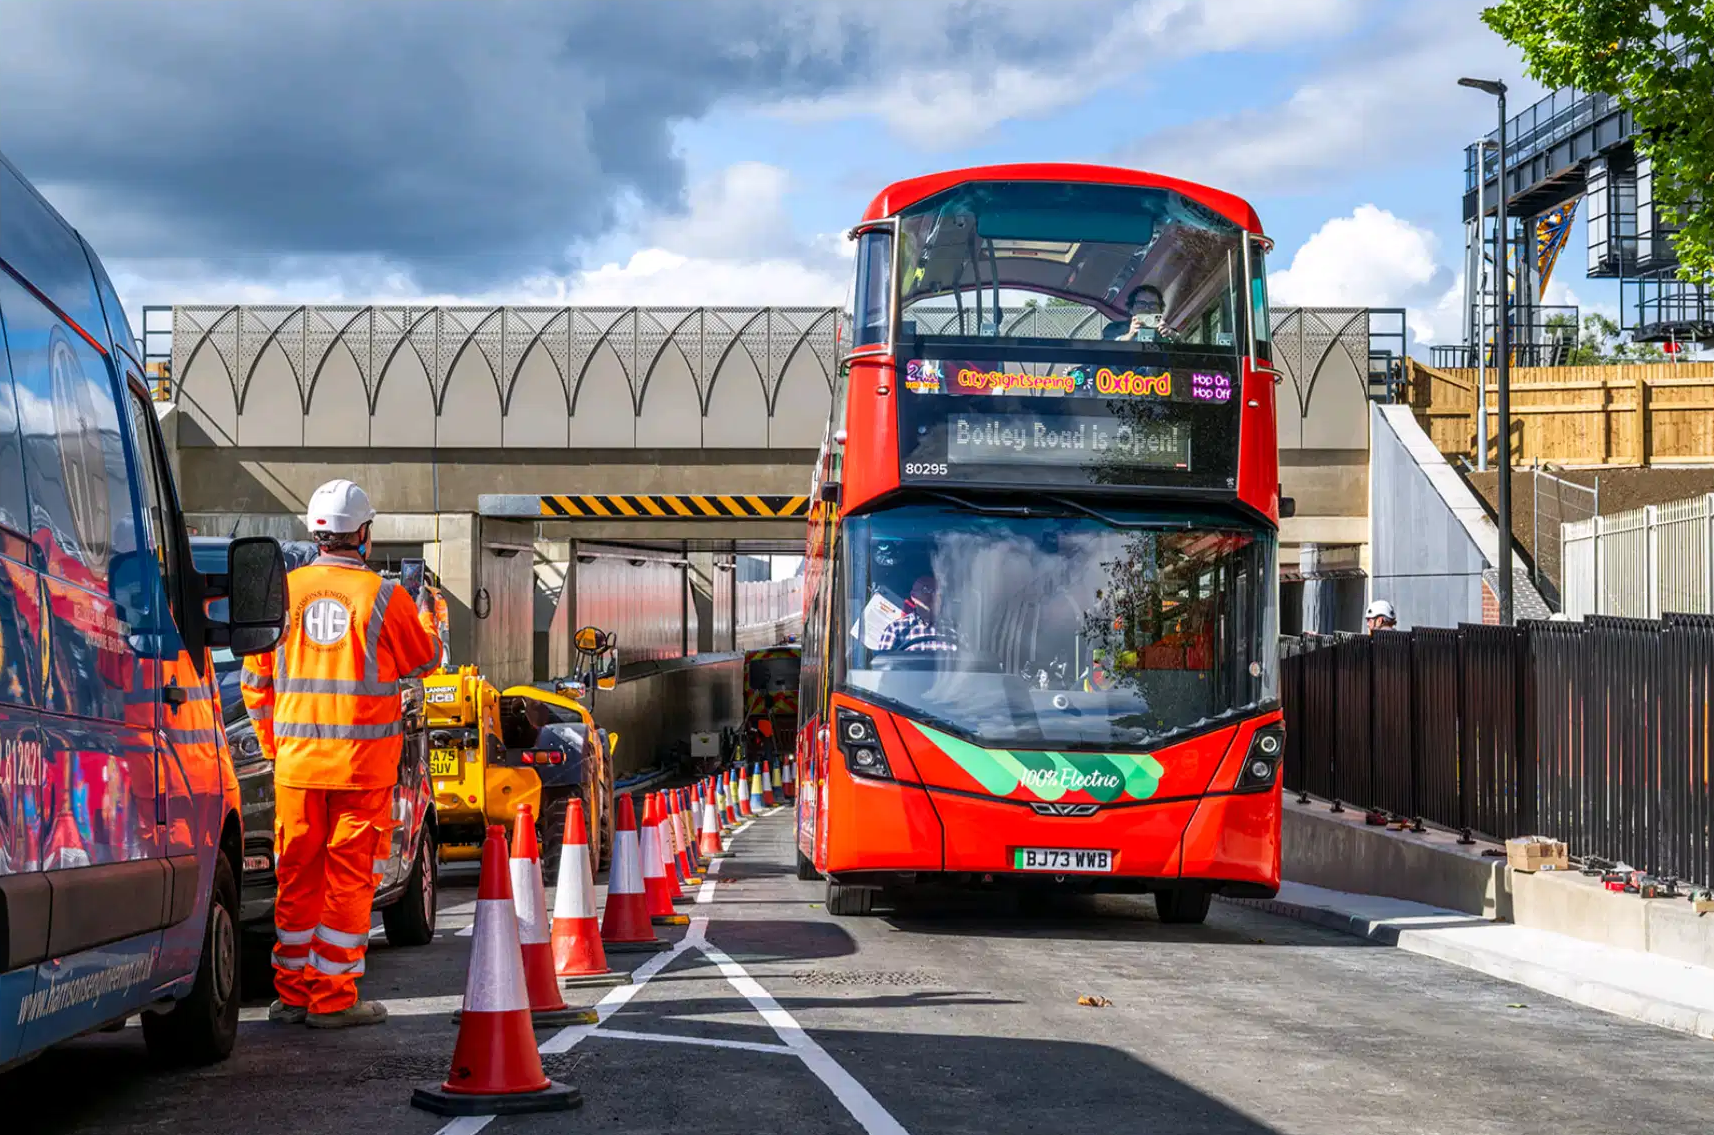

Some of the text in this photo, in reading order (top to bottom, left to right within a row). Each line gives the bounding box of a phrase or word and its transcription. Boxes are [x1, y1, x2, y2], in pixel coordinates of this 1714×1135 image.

[1096, 368, 1171, 396] Oxford
[1193, 372, 1229, 387] Hop On
[1193, 386, 1231, 399] Hop Off
[957, 418, 1178, 455] Botley Road is Open!
[905, 464, 948, 476] 80295
[427, 692, 454, 703] JCB
[0, 738, 41, 785] 812821
[1019, 767, 1120, 788] 100% Electric
[1026, 850, 1108, 868] BJ73 WWB
